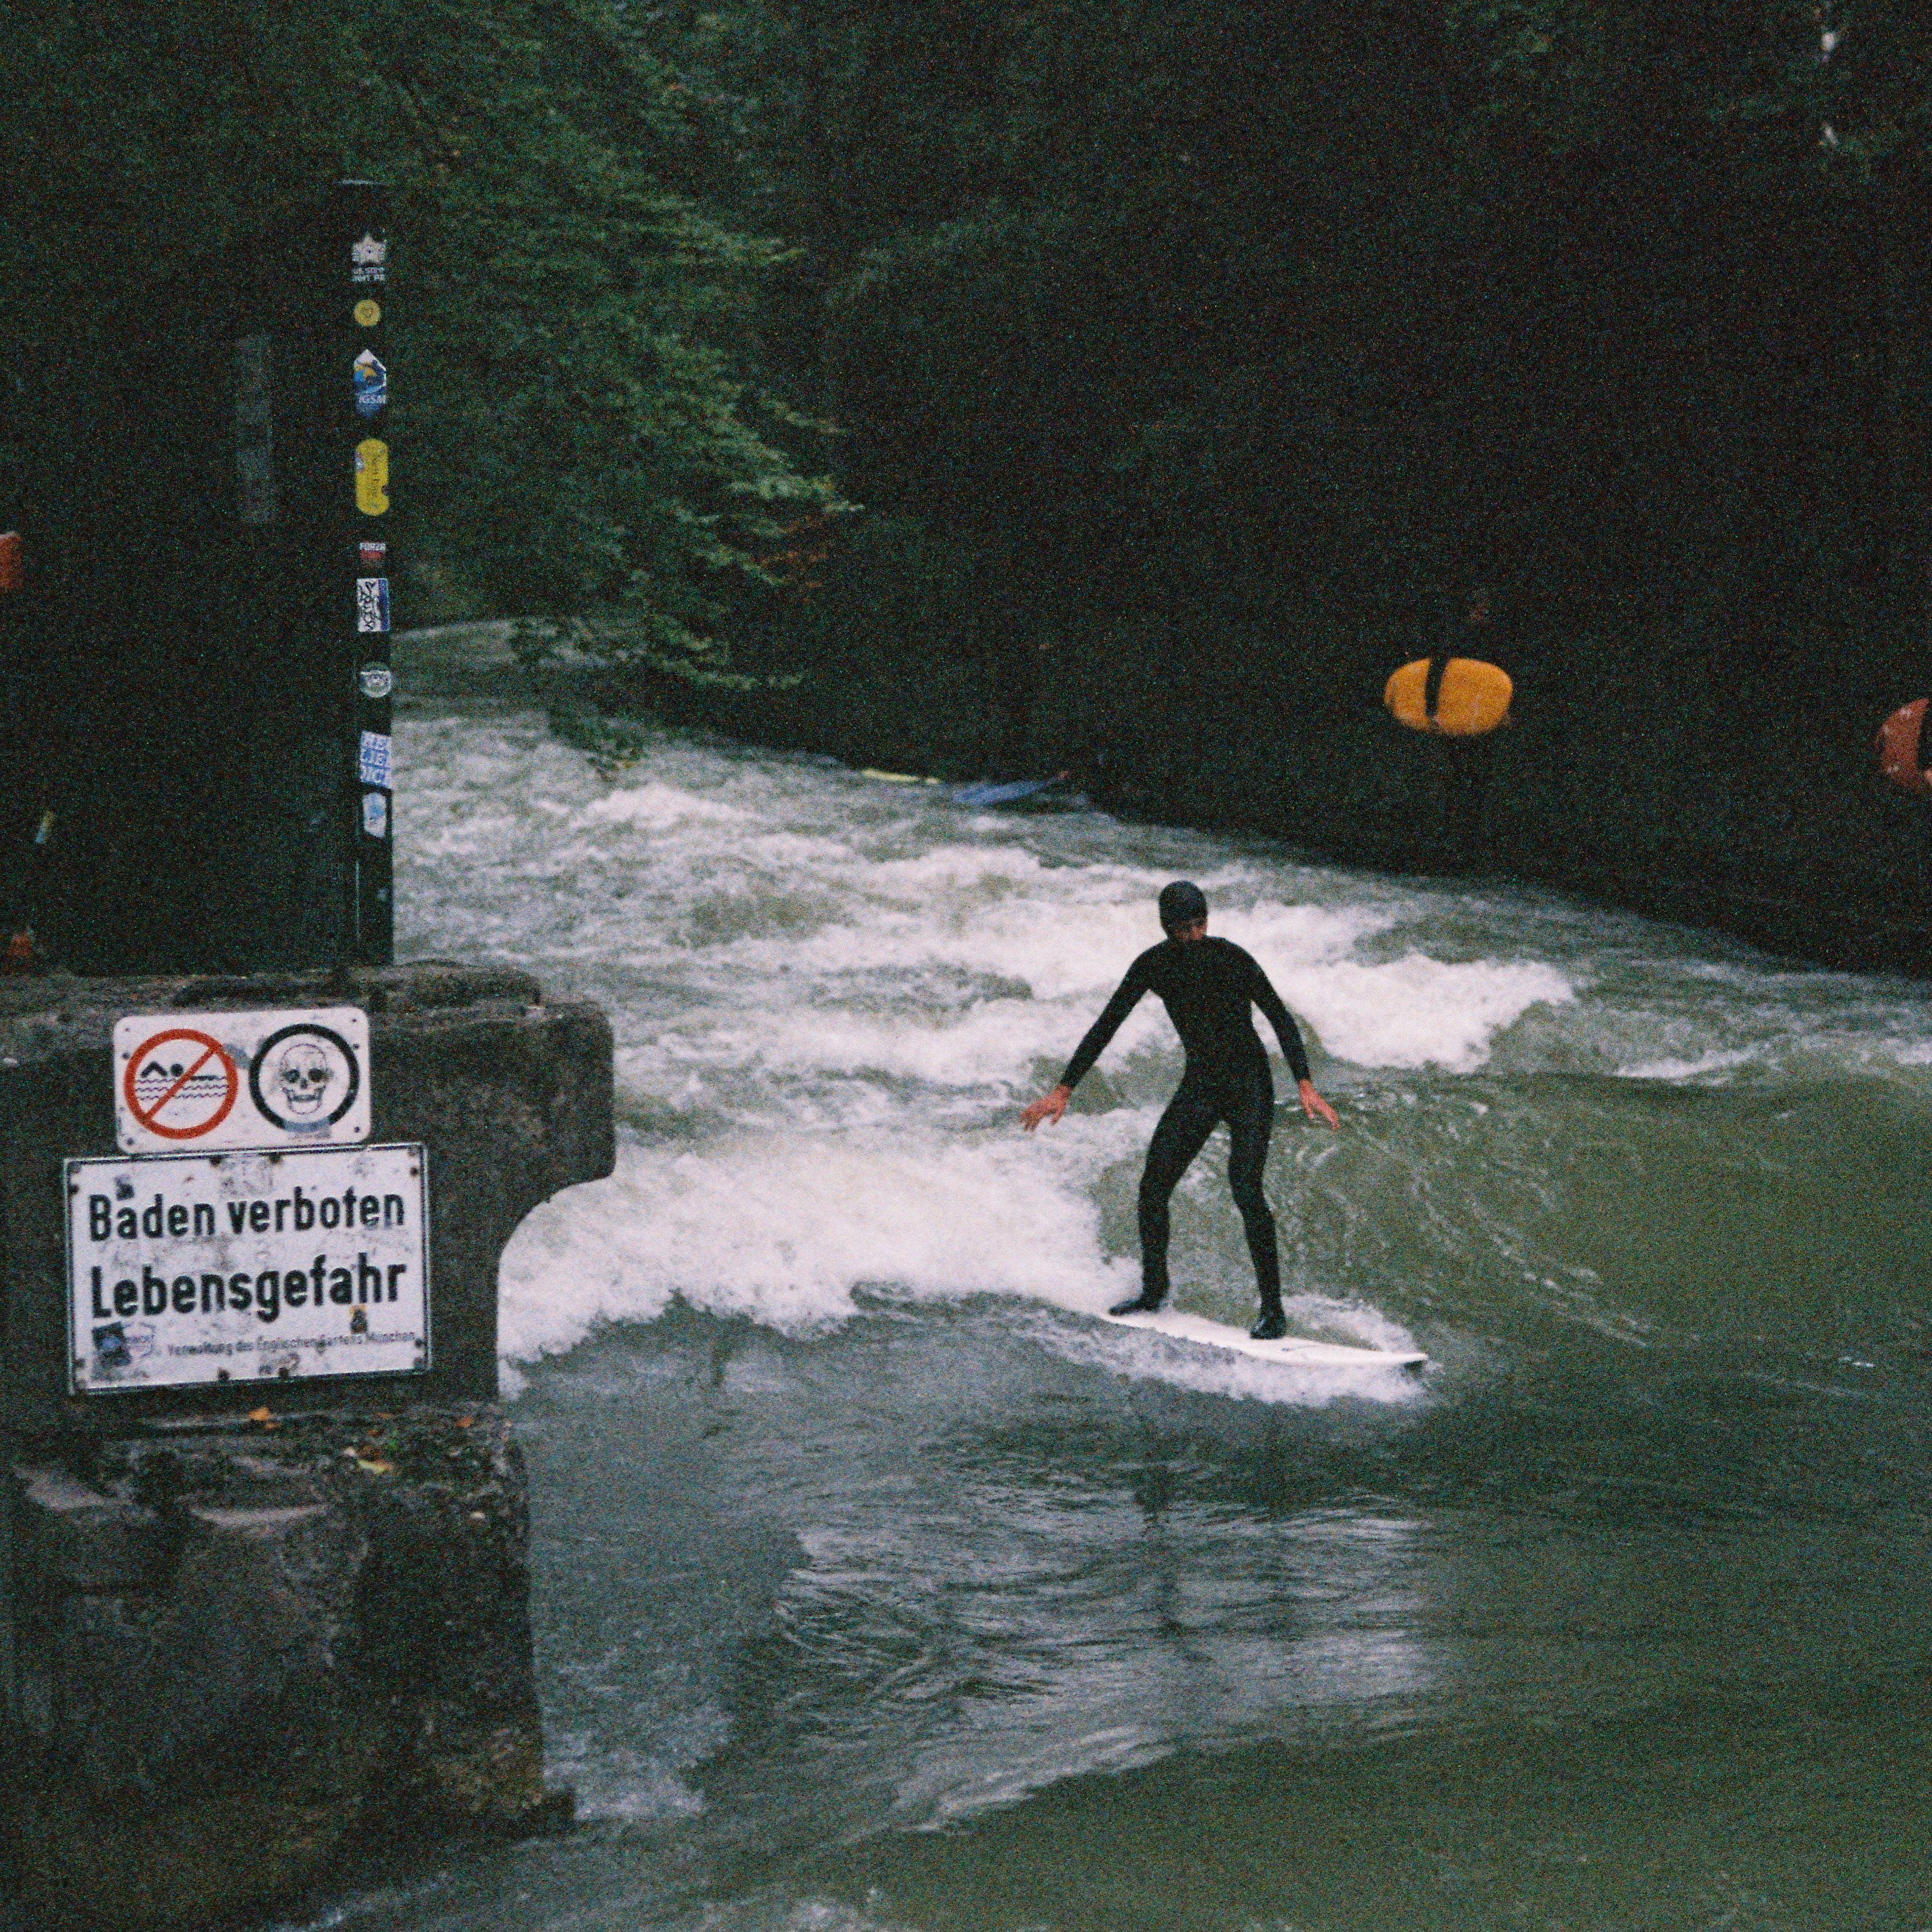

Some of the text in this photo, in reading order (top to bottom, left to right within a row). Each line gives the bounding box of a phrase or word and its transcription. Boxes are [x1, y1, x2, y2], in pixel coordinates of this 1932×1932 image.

[89, 1186, 405, 1241] Baden verboten
[90, 1252, 407, 1324] Lebensgefahr
